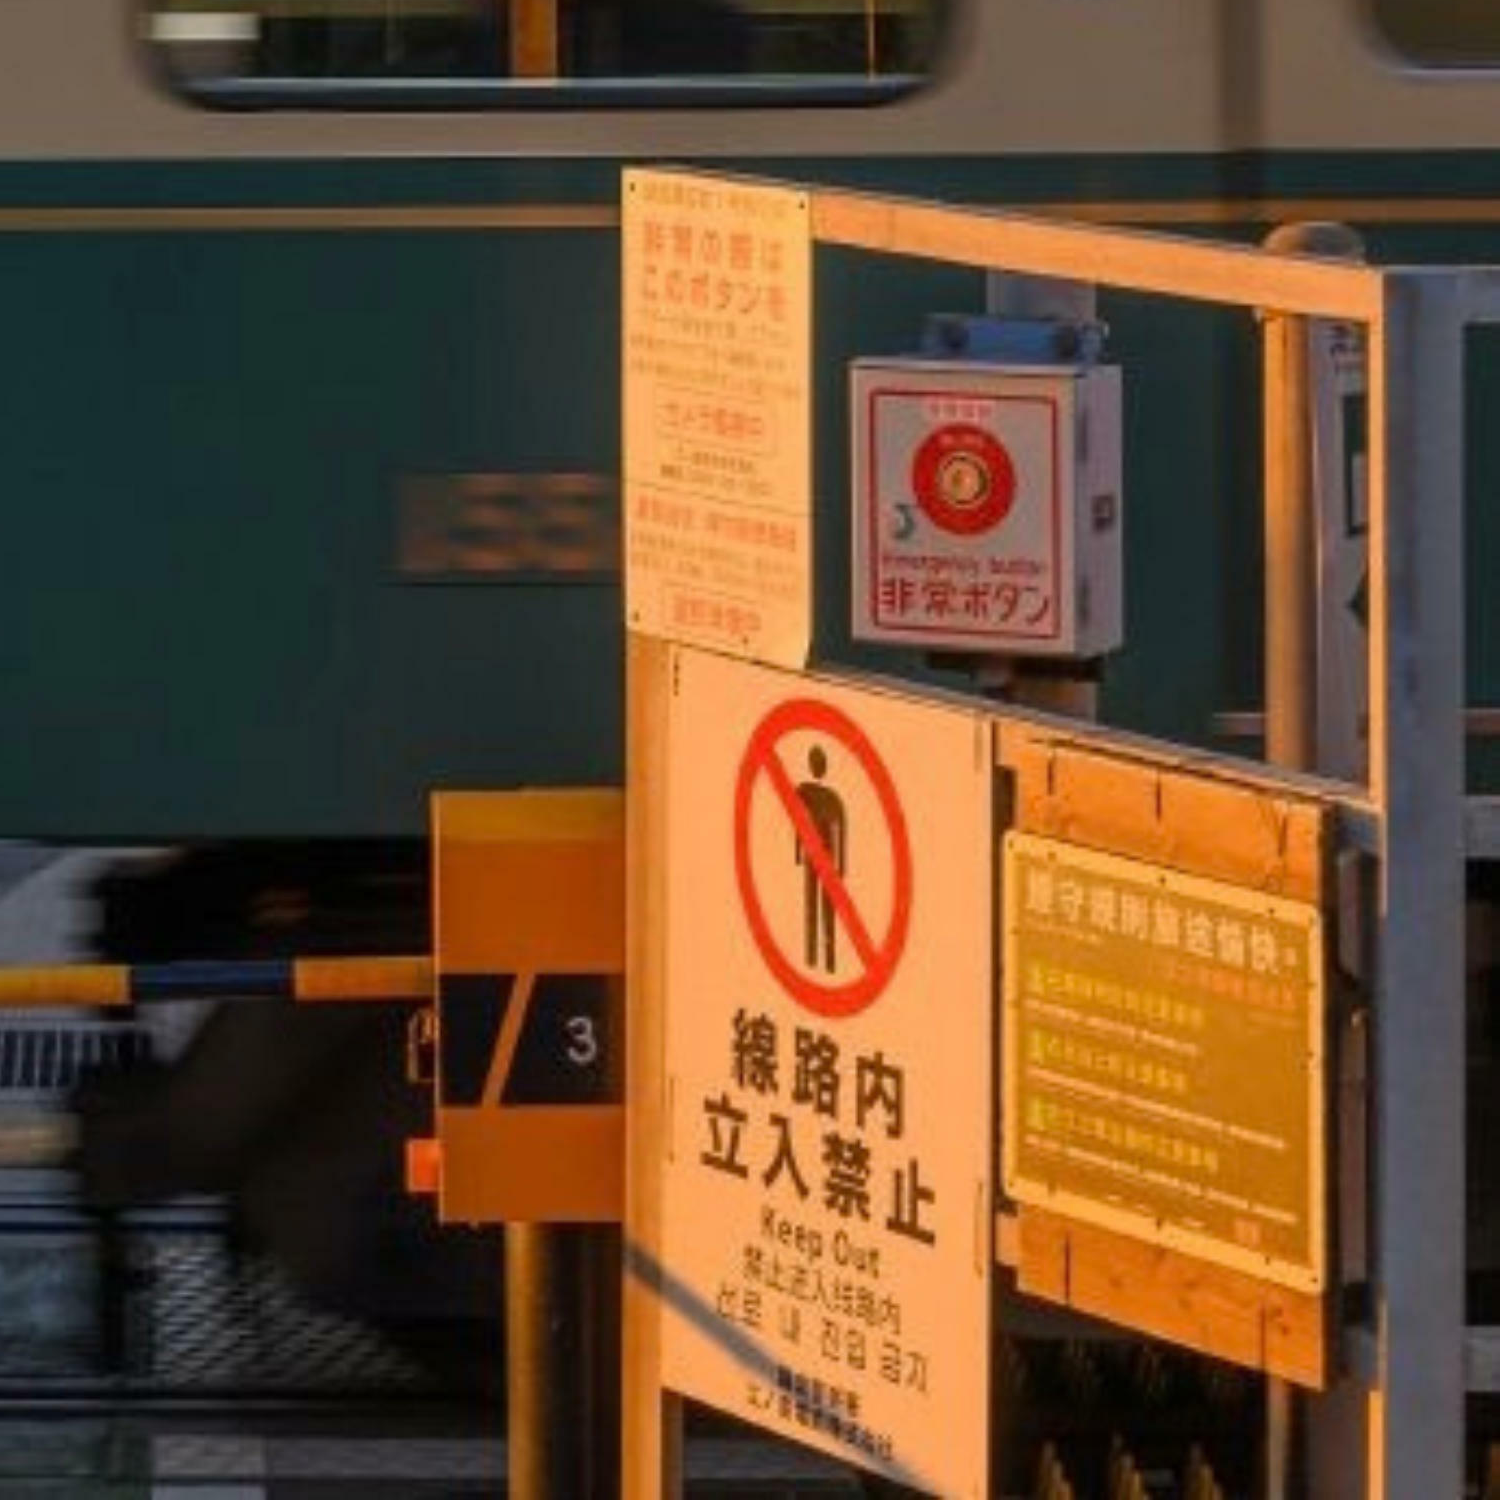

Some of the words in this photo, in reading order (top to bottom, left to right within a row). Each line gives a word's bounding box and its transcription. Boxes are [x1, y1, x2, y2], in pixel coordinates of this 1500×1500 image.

[880, 577, 1049, 626] 非常ボタン
[564, 1015, 598, 1065] 3
[730, 1008, 906, 1140] 線路内
[699, 1091, 936, 1247] 立入禁止
[760, 1205, 823, 1261] Keep
[833, 1228, 880, 1280] Out
